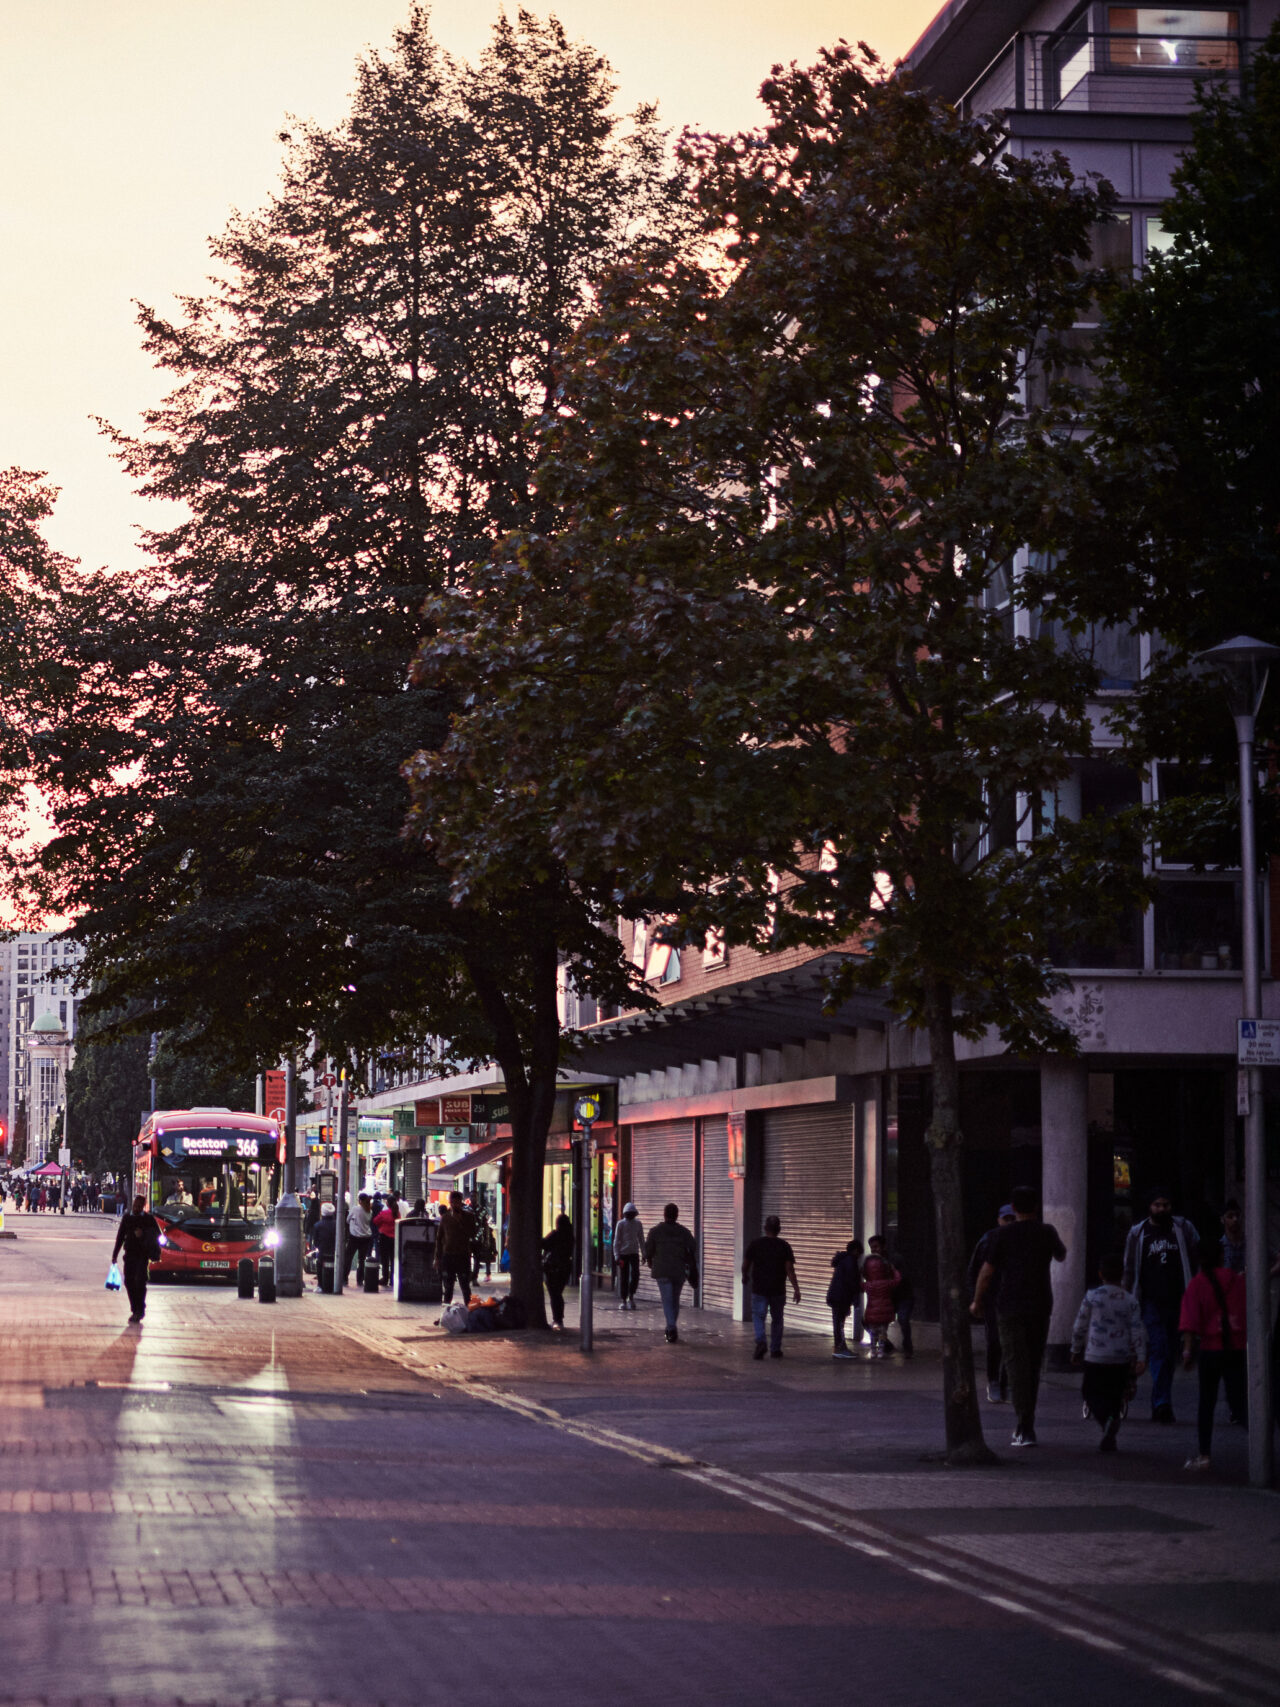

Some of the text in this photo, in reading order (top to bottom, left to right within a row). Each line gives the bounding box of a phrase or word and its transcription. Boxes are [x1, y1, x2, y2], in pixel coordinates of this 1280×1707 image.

[183, 1137, 258, 1156] Beckton 366
[202, 1242, 216, 1252] Go
